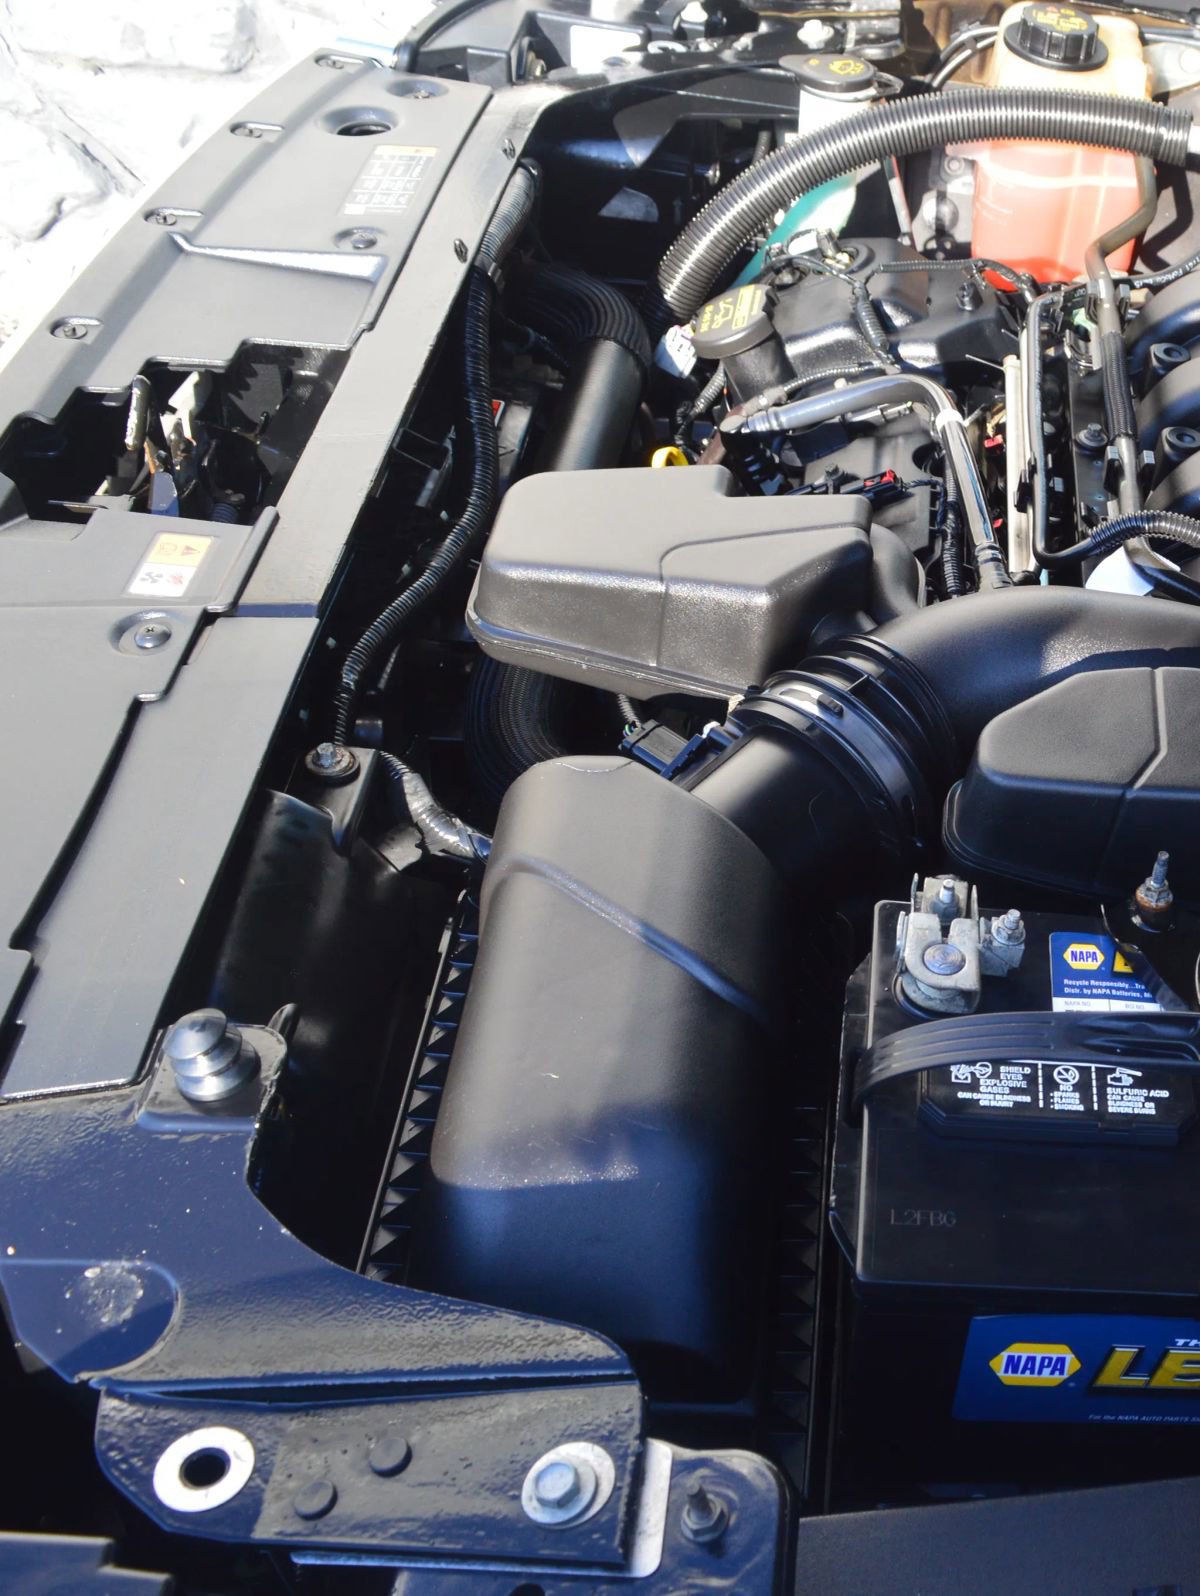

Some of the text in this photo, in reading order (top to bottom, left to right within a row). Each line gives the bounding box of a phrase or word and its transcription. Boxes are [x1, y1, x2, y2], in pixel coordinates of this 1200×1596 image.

[1070, 950, 1099, 963] NAPA
[1000, 1065, 1031, 1074] SHIELD
[980, 1079, 1028, 1088] EXPLOSIVE
[980, 1086, 1010, 1094] GASES
[1107, 1087, 1170, 1098] SULFURIC ACID
[1003, 1354, 1069, 1377] NAPA
